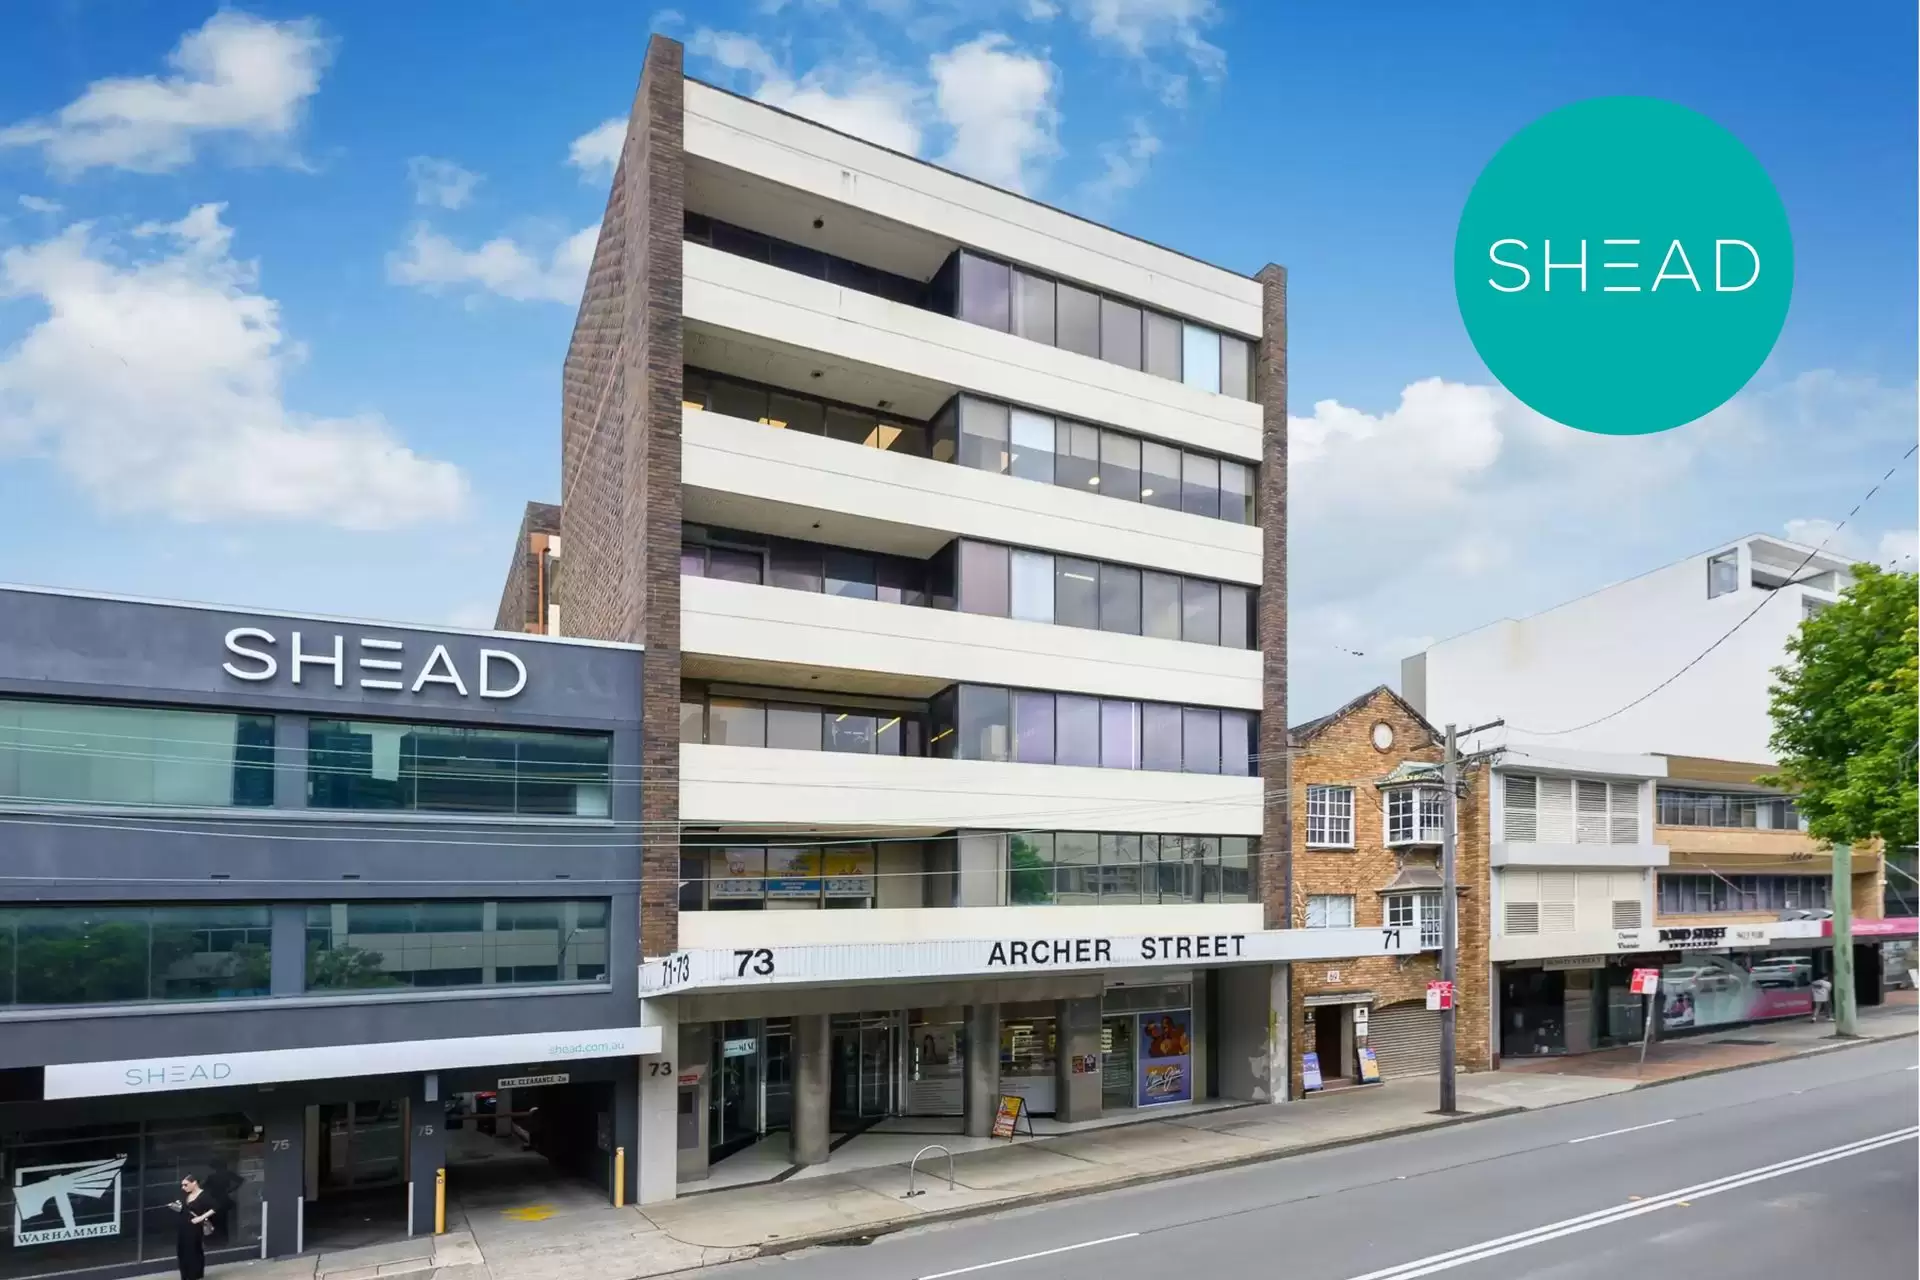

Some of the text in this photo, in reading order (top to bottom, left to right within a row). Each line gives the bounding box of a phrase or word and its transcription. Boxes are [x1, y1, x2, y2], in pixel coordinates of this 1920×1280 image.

[222, 627, 528, 698] SHEAD
[1382, 929, 1400, 949] 71
[987, 935, 1246, 966] ARCHER STREET
[662, 953, 690, 987] 71-73
[733, 948, 775, 978] 73
[547, 1040, 625, 1055] shead.com.au
[125, 1062, 231, 1086] SHEAD
[648, 1061, 672, 1077] 73
[518, 1076, 555, 1086] CLEARANCE
[17, 1224, 118, 1245] WARHAMMER
